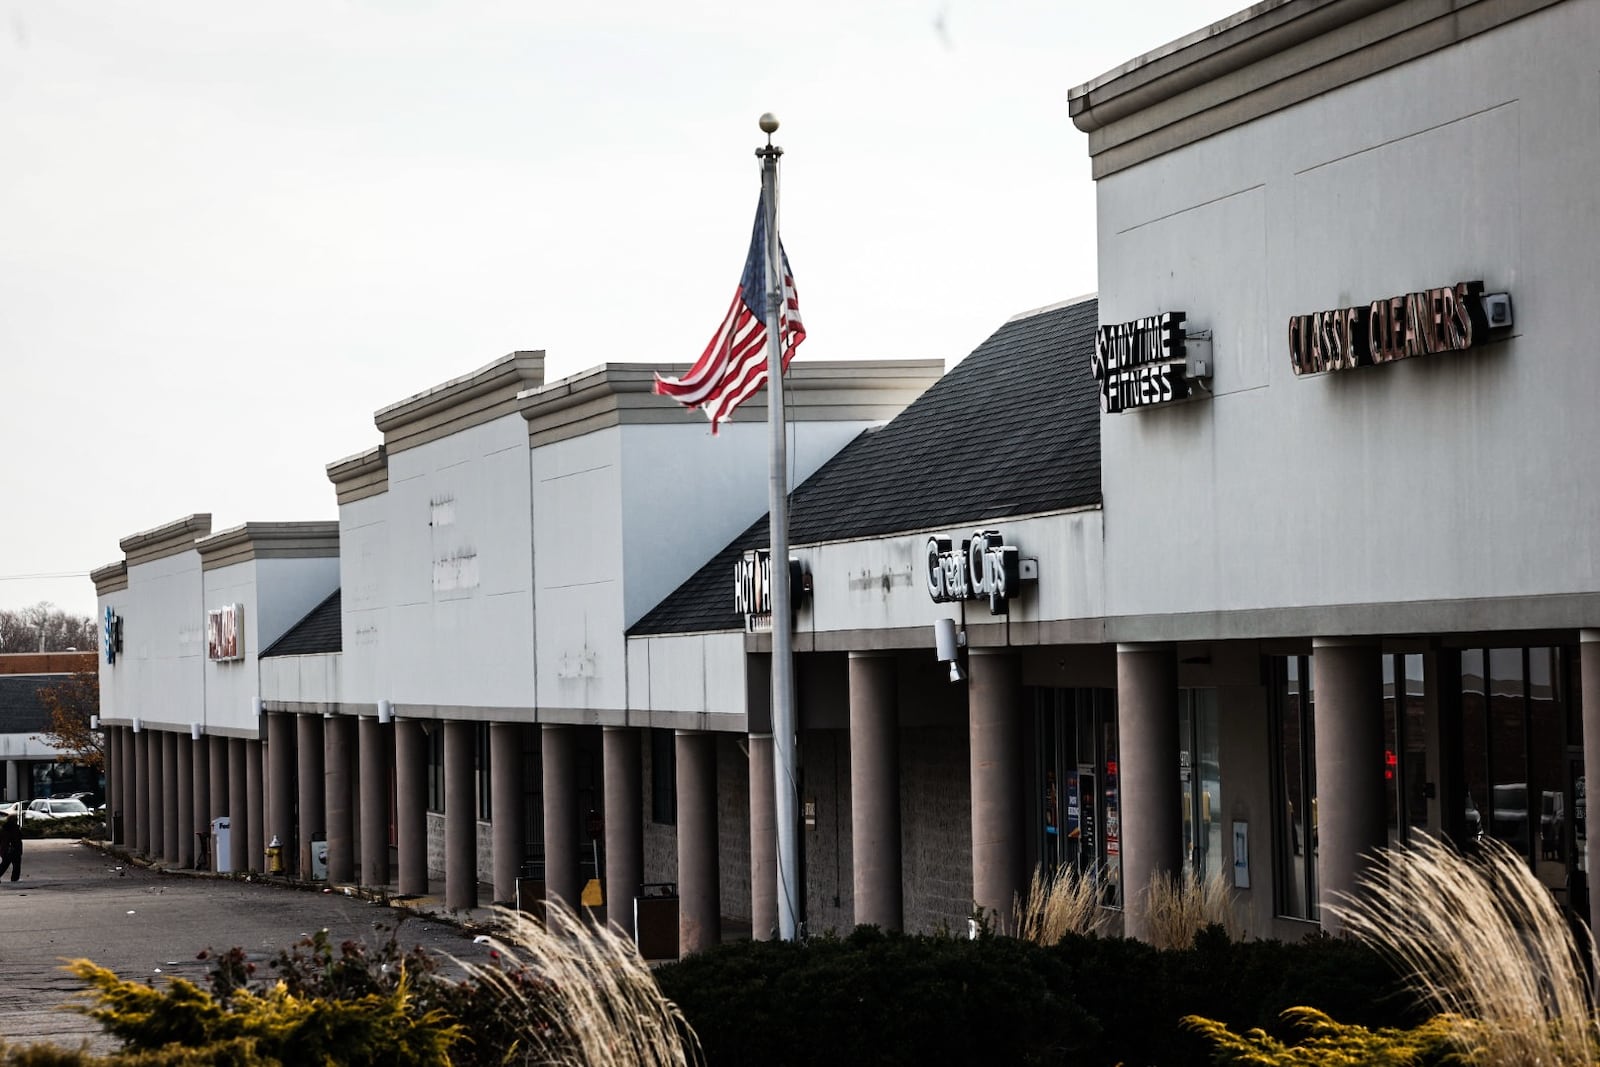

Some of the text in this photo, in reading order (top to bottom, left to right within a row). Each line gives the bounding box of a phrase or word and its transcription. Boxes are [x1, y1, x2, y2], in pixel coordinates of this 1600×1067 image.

[1108, 312, 1172, 369] ANYTIME
[1289, 282, 1473, 375] CLASSIC CLEANERS
[1109, 365, 1173, 410] FITNESS
[927, 533, 1006, 612] Great Clips
